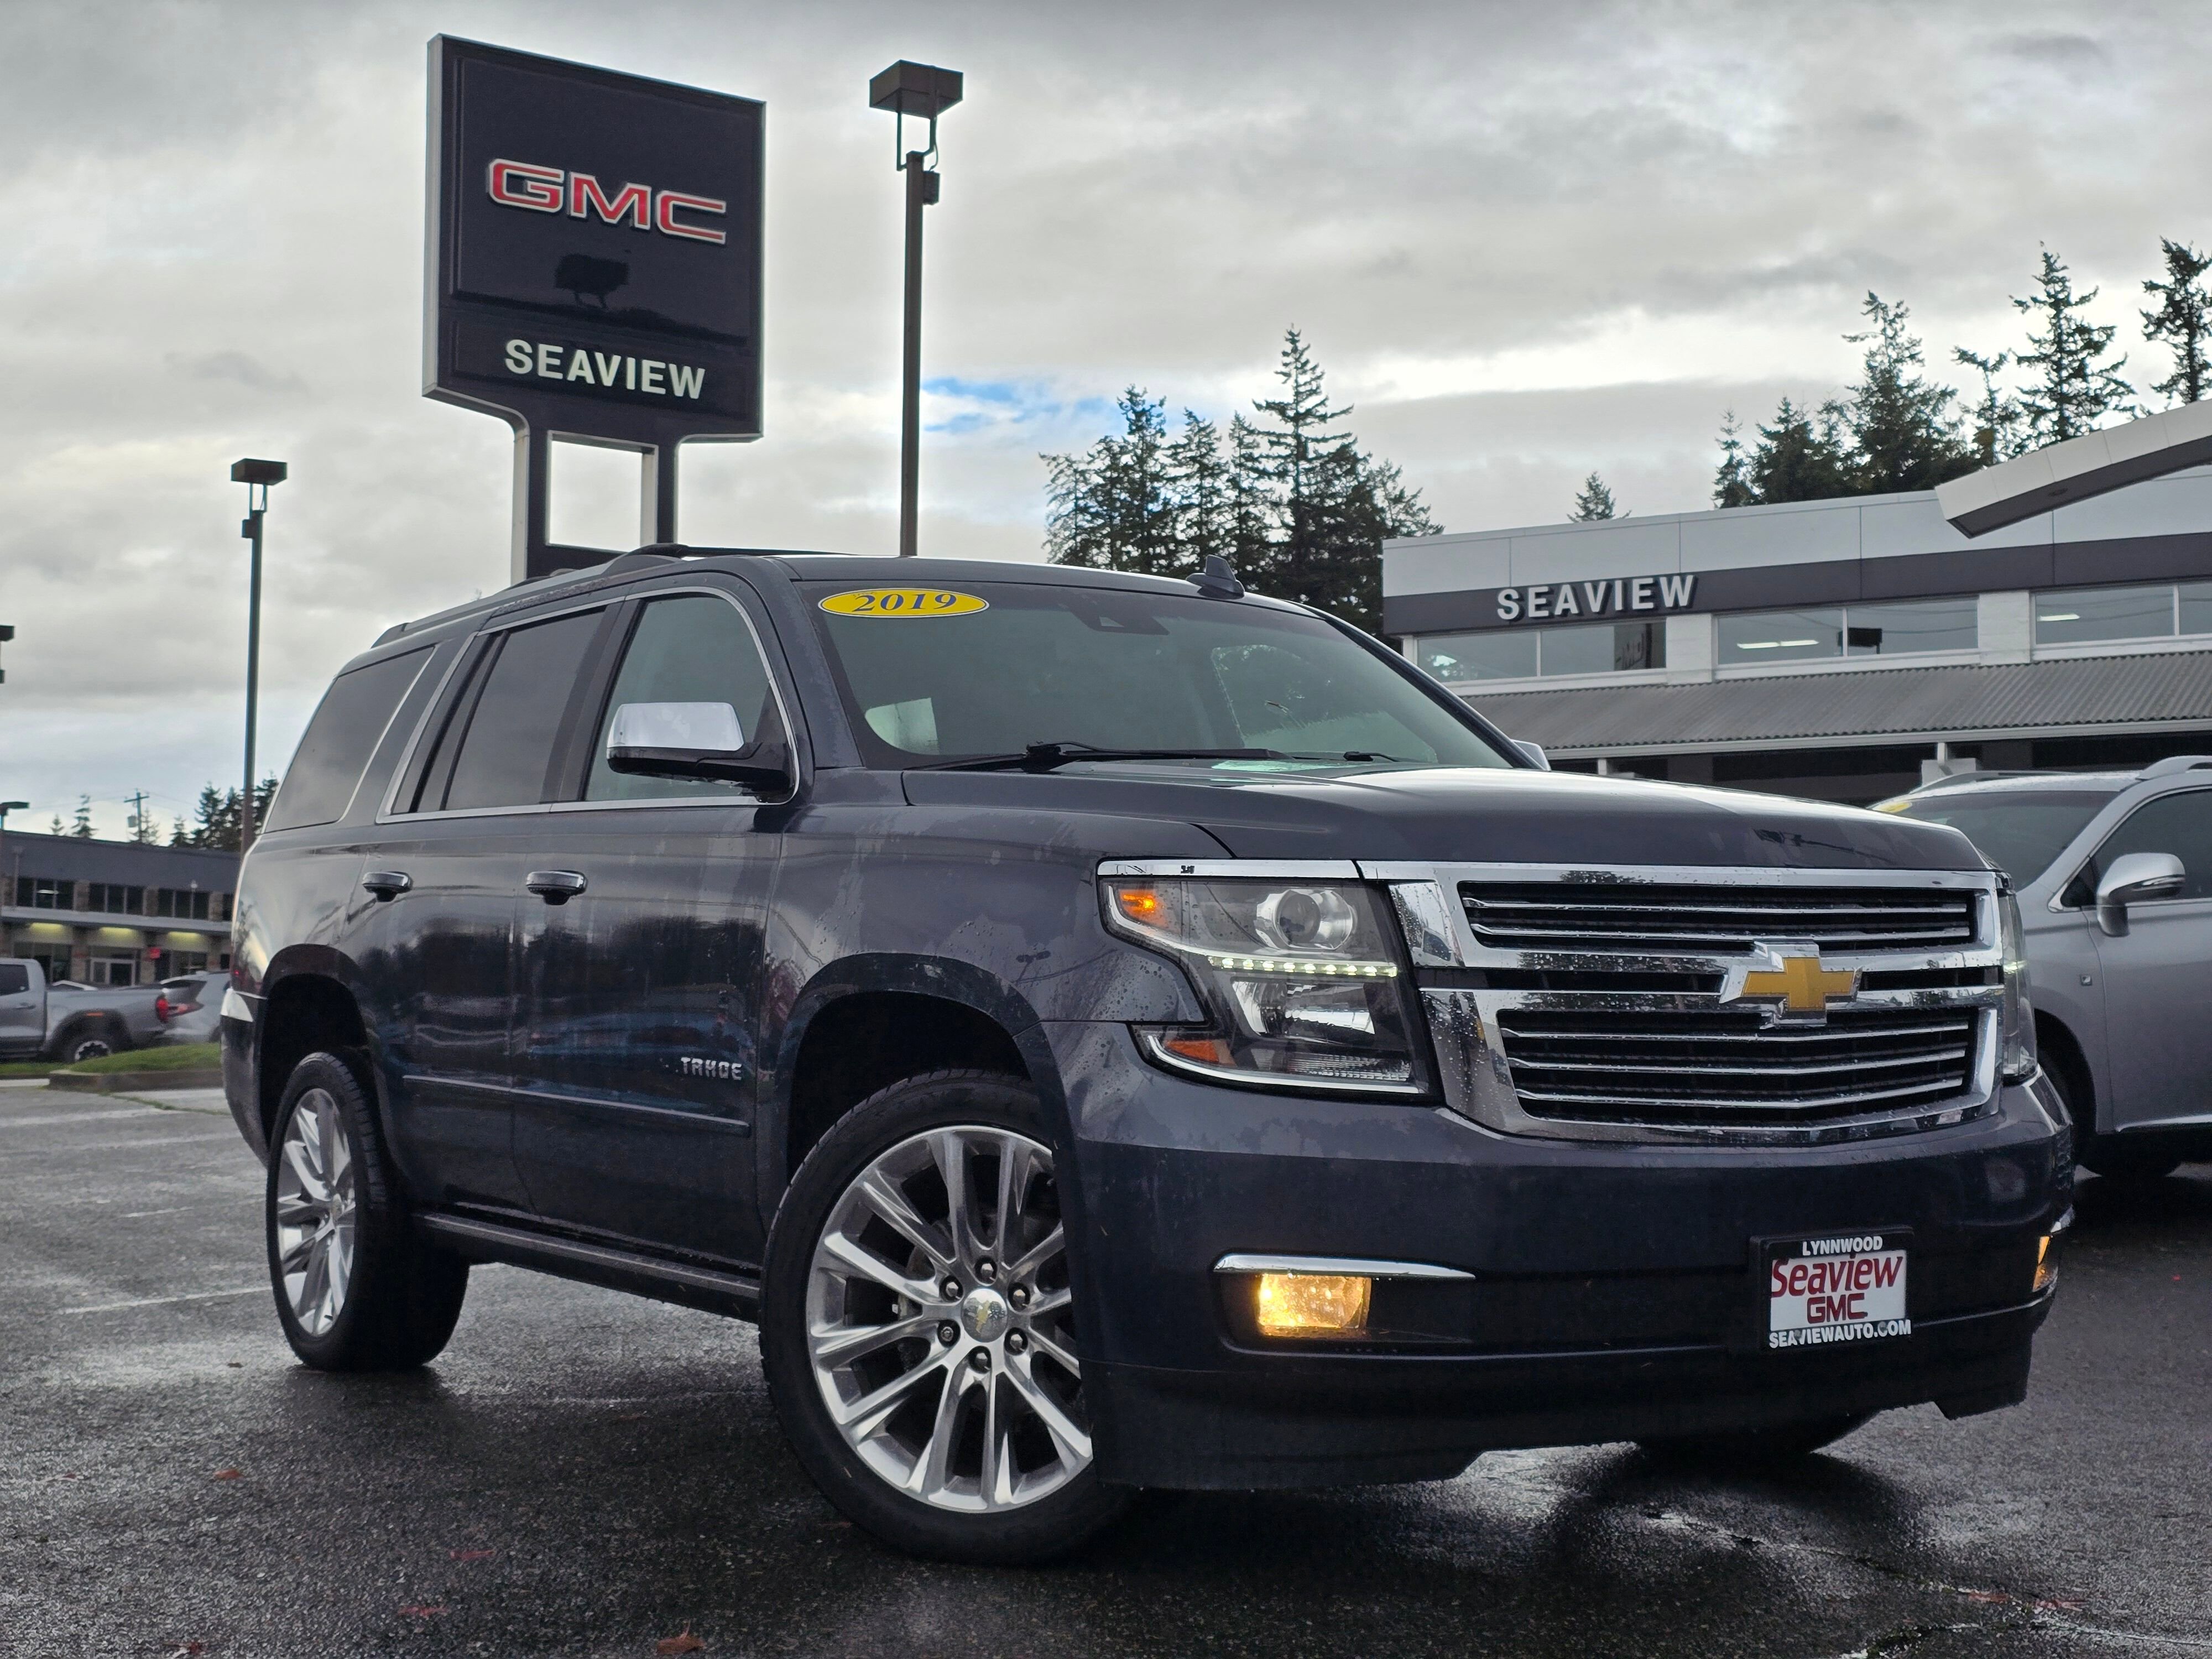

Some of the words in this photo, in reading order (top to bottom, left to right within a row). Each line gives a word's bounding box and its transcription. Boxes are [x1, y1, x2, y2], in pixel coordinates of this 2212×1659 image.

[487, 158, 726, 244] GMC
[504, 338, 706, 399] SEAVIEW
[852, 593, 957, 612] 2019
[1496, 574, 1694, 620] SEAVIEW
[680, 1057, 742, 1081] TAHOE
[1802, 1236, 1883, 1256] LYNNWOOD
[1771, 1253, 1903, 1298] Seaview
[1807, 1293, 1868, 1324] GMC
[1770, 1319, 1912, 1349] SEAVIEWAUTO.COM
